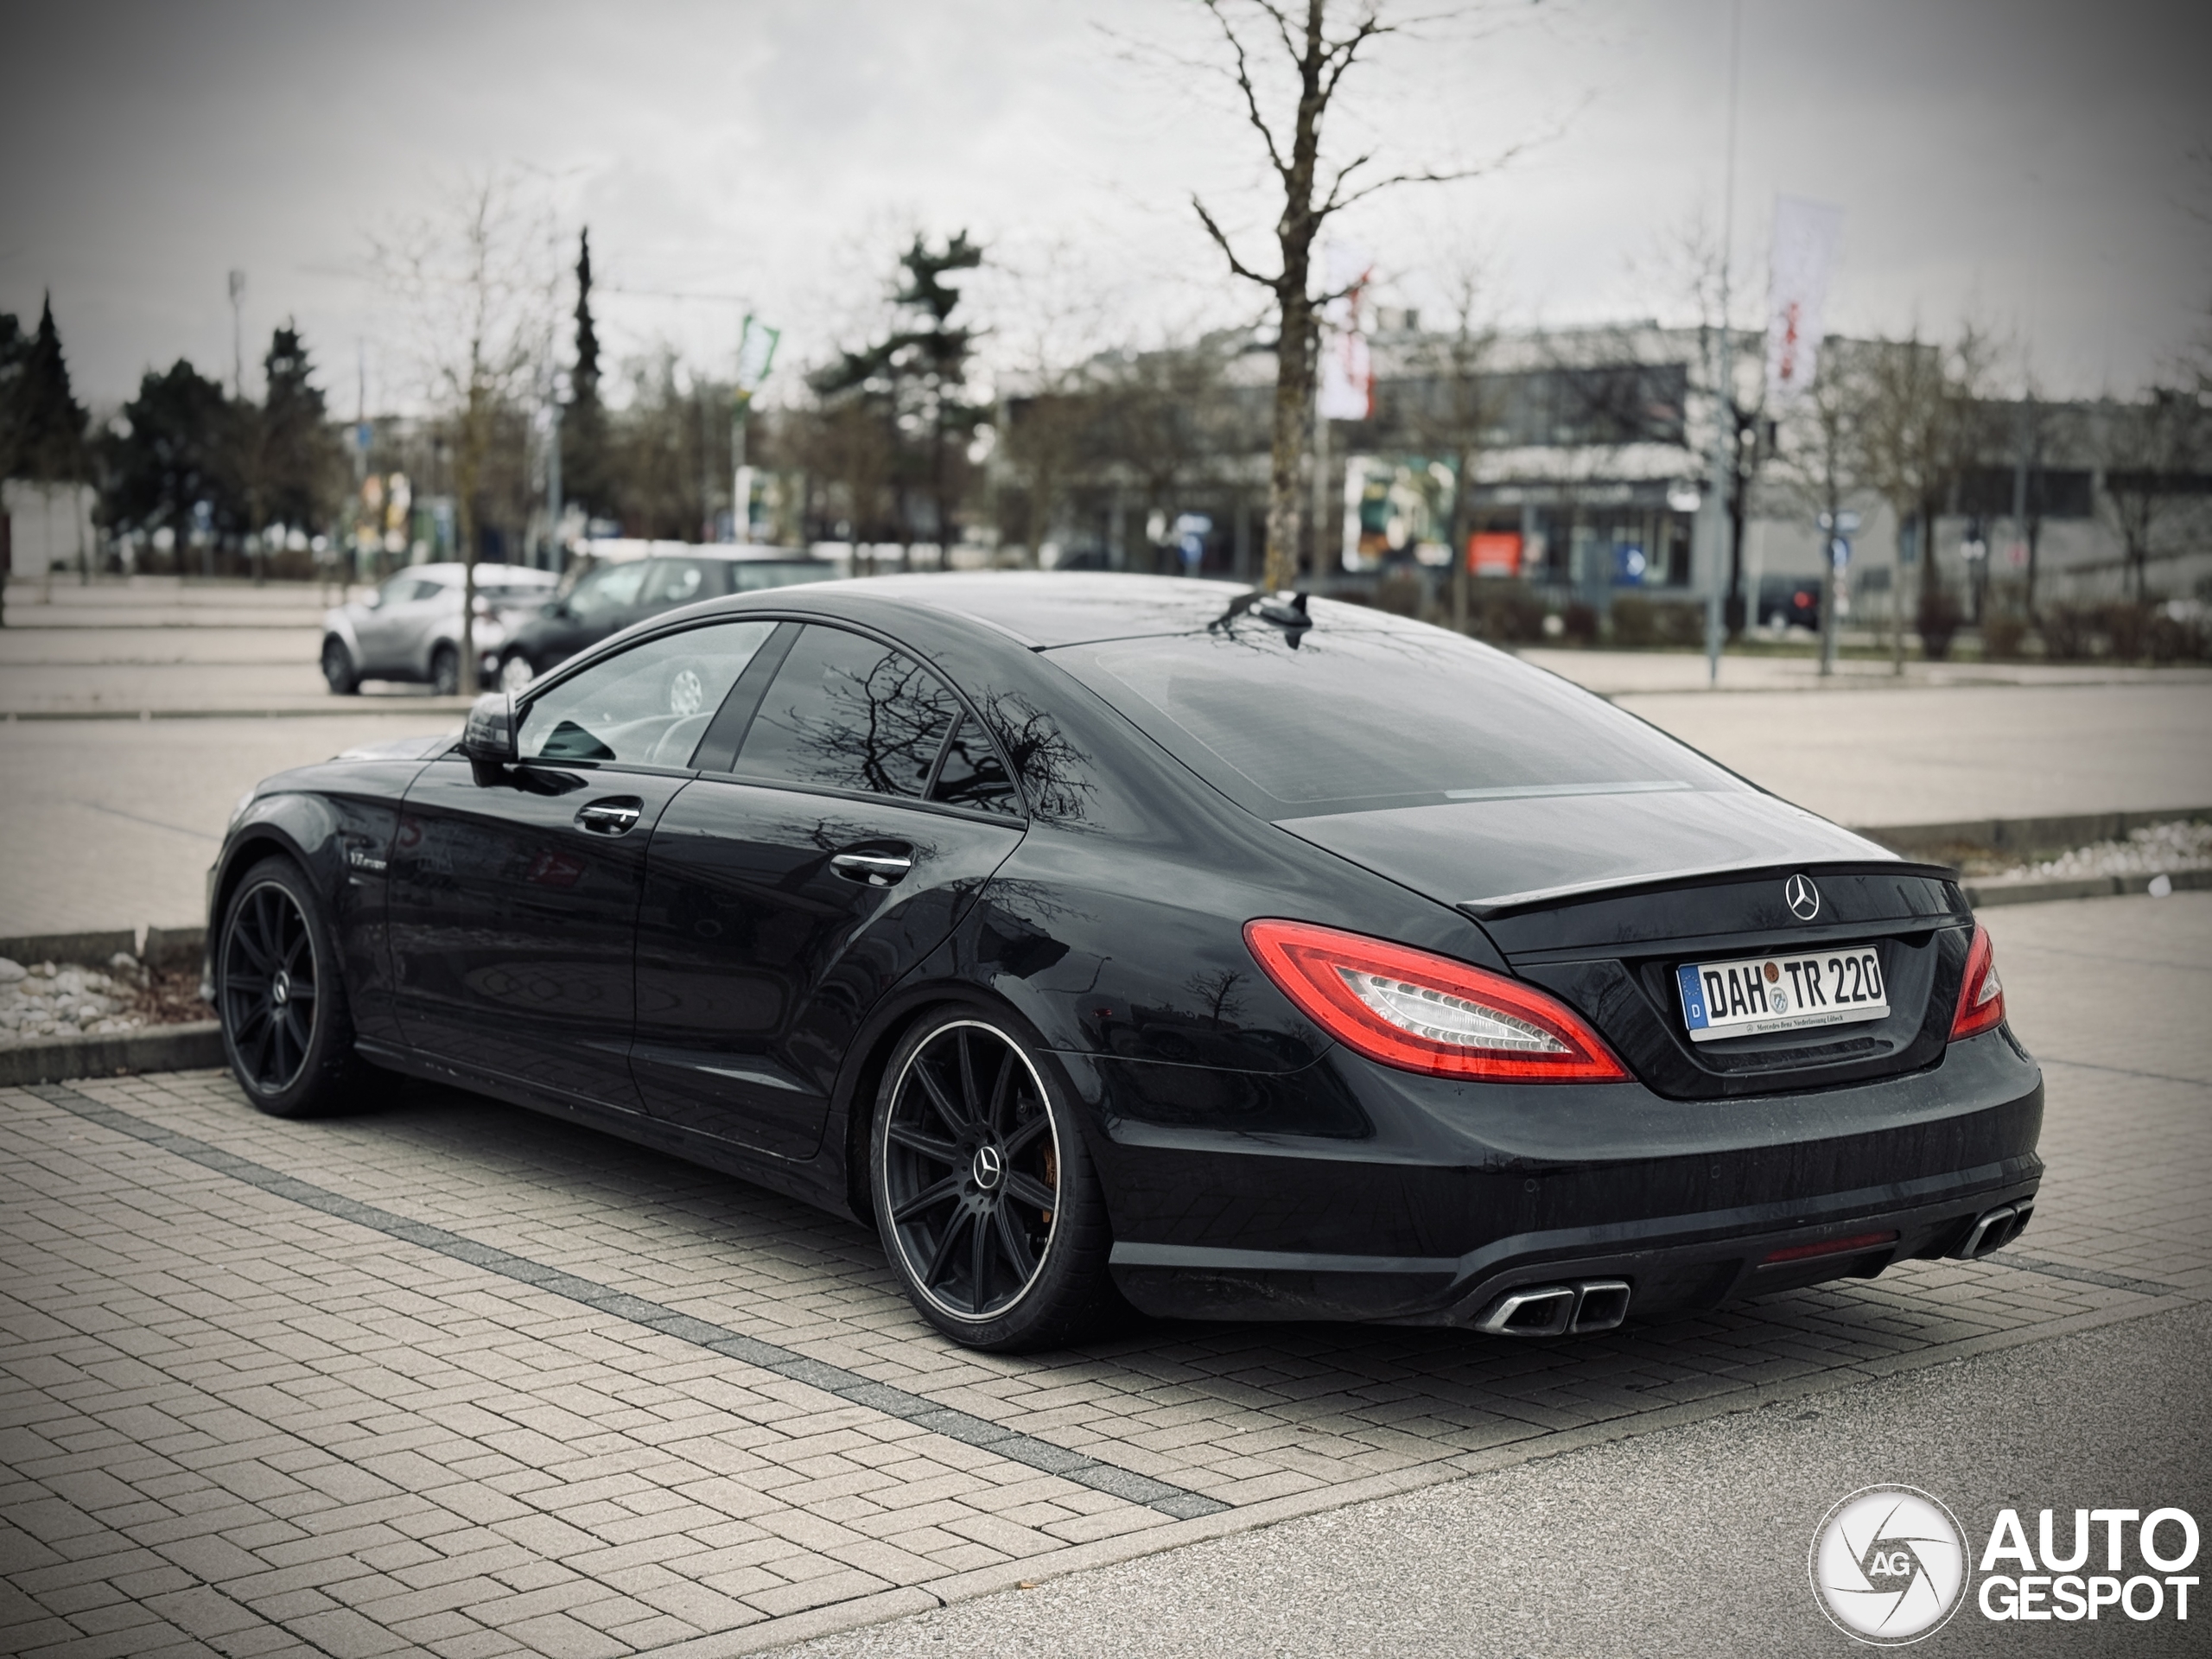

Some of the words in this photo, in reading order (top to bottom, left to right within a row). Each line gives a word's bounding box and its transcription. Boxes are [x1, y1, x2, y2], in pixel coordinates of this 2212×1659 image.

[1703, 965, 1768, 1018] DAH
[1784, 961, 1827, 1007] TR
[1828, 955, 1882, 1003] 220
[1691, 1004, 1700, 1018] D
